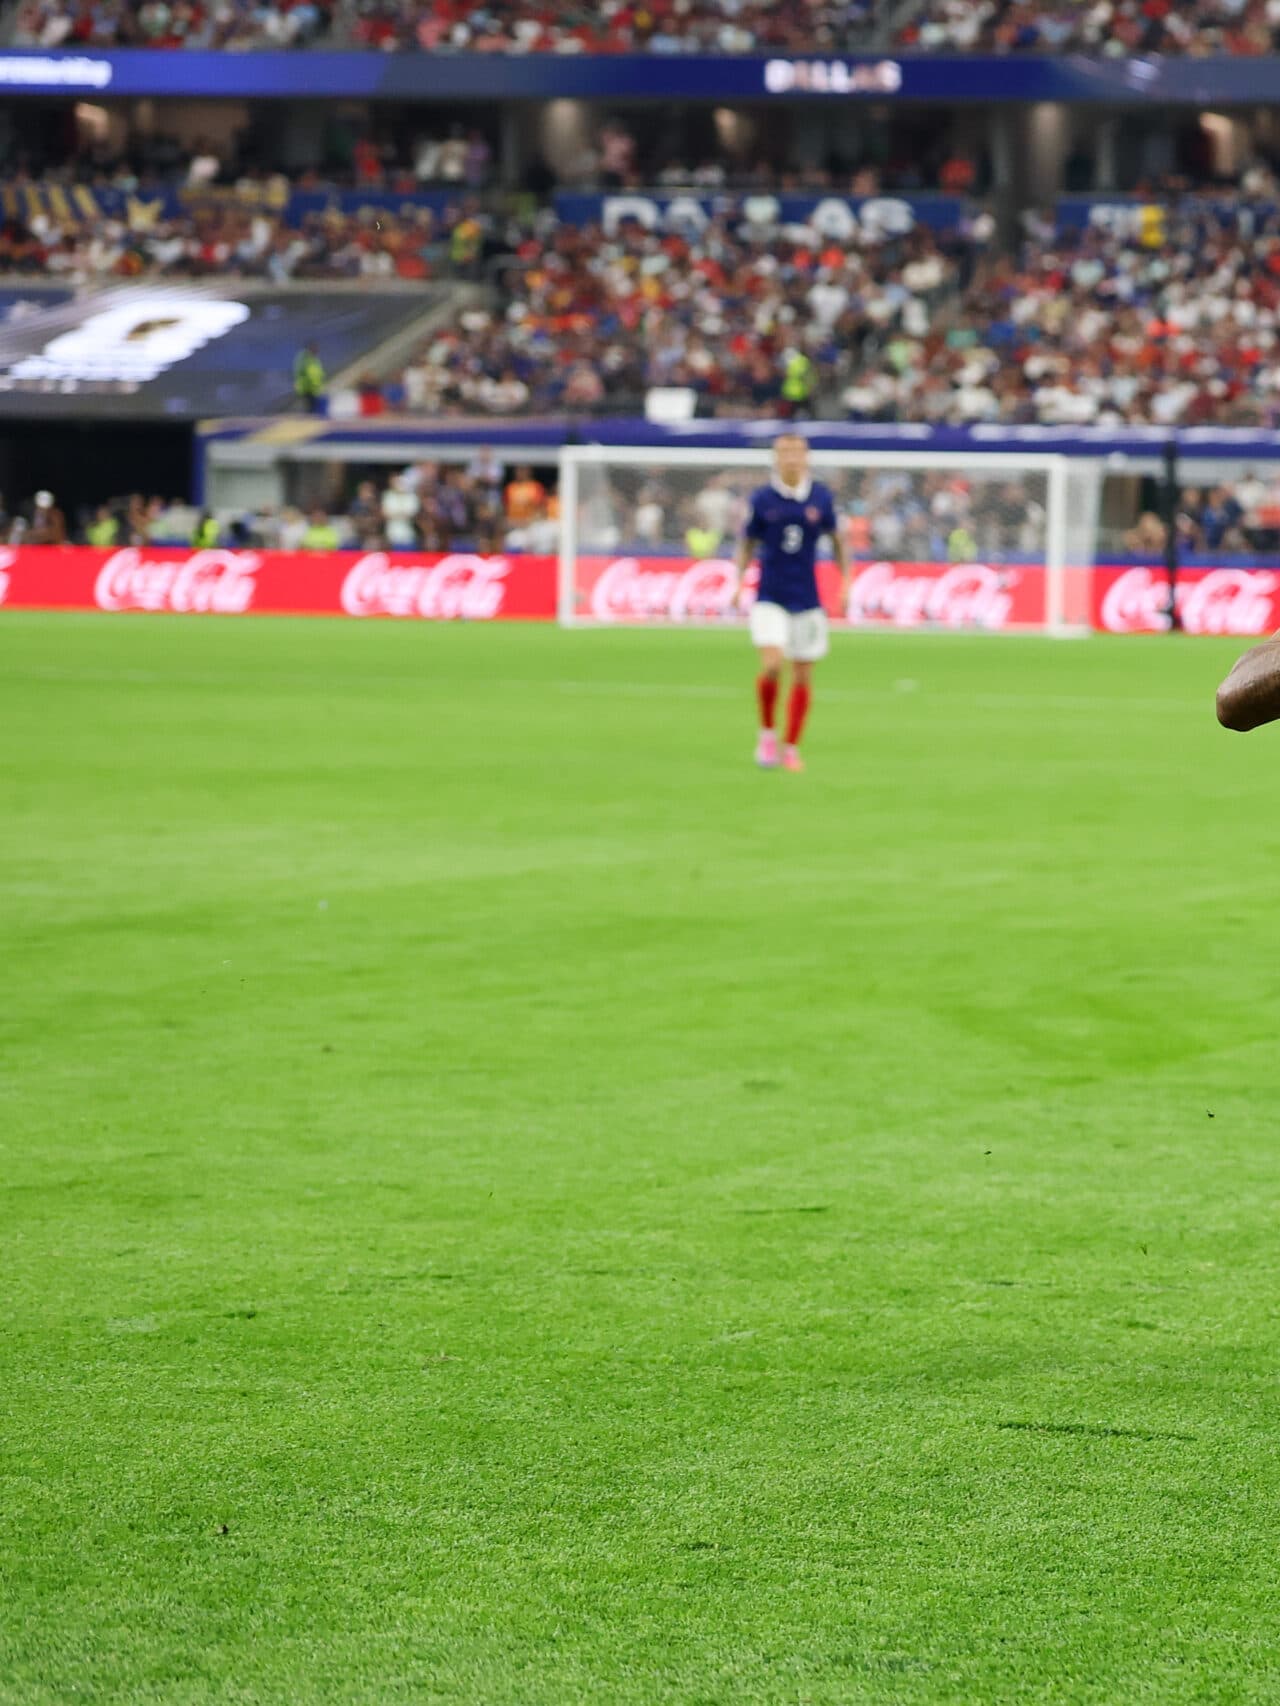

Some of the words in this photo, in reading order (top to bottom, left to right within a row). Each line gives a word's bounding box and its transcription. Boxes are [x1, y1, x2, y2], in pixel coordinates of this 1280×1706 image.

[94, 547, 262, 612] Coca-Cola
[341, 552, 510, 618] Coca-Cola
[848, 562, 1021, 628] Coca-Cola
